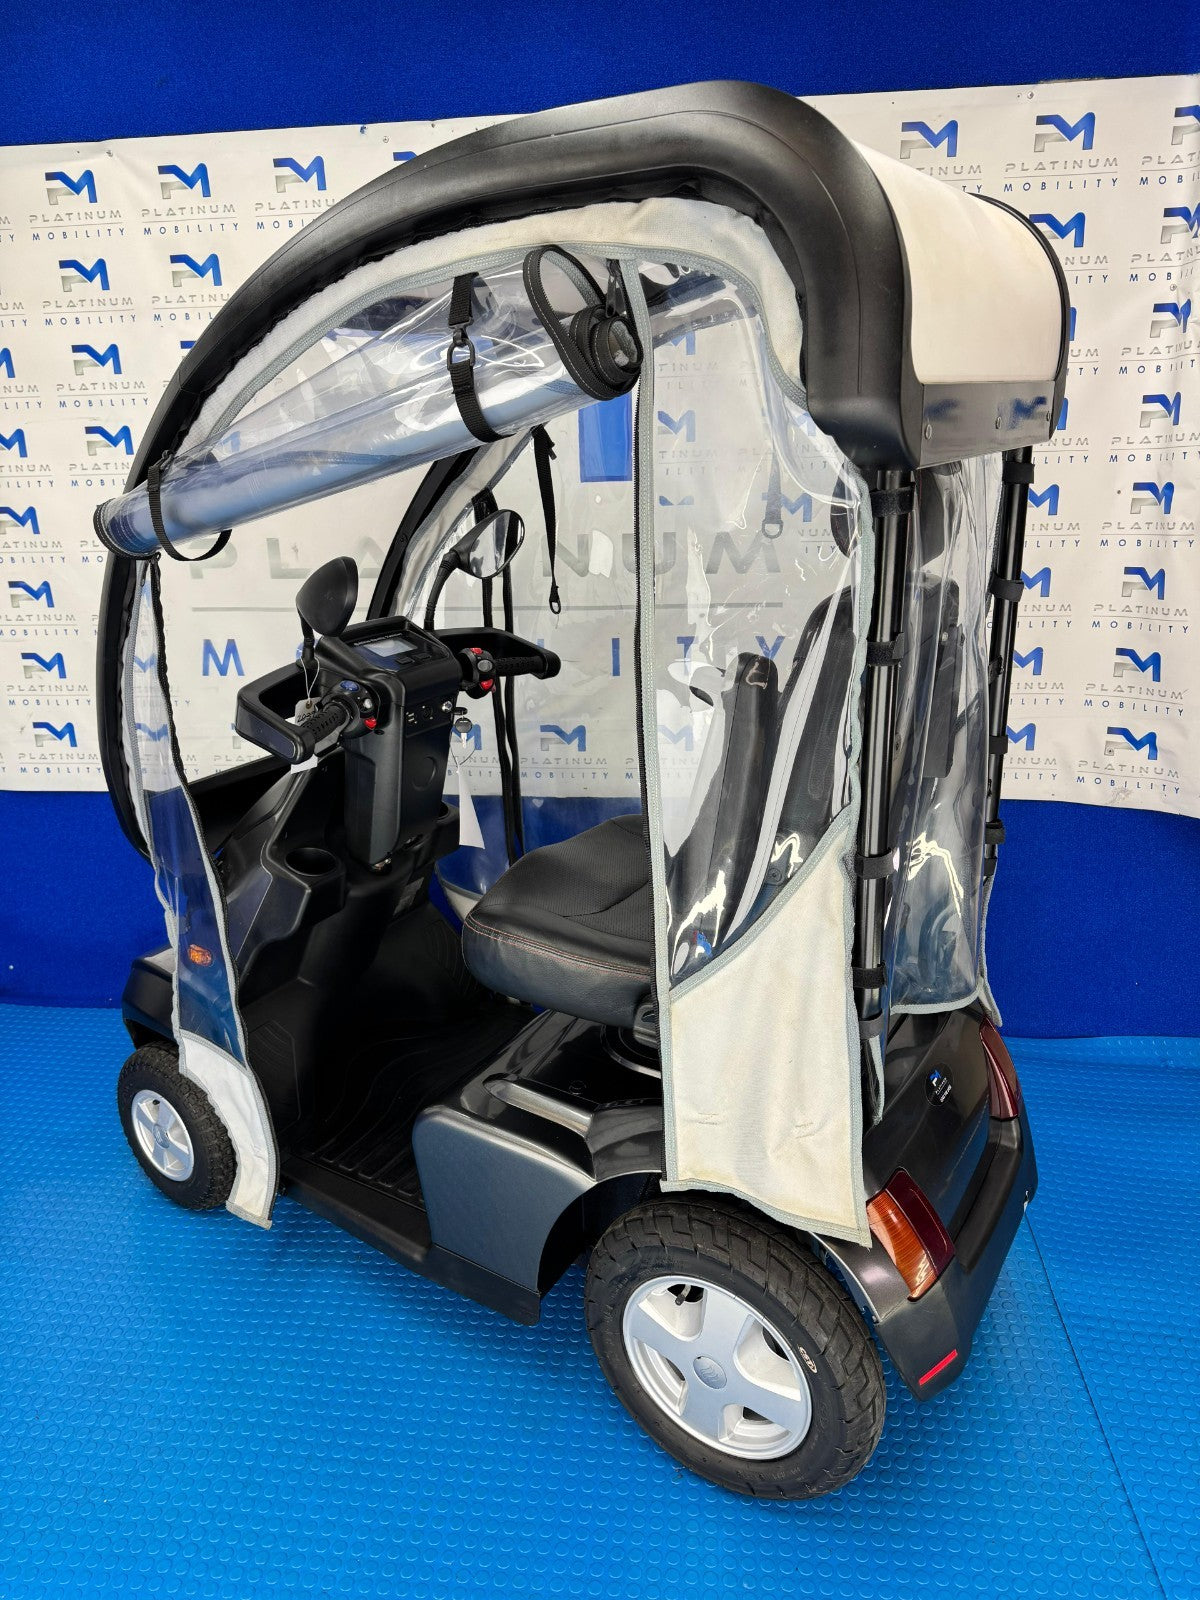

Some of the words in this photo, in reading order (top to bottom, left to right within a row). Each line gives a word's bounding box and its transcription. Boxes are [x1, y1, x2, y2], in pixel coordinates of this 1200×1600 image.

[1004, 157, 1118, 172] PLATINUM
[1003, 178, 1118, 192] MOBILITY
[141, 203, 236, 217] PLATINUM
[255, 198, 335, 211] PLATINU
[29, 209, 122, 223] PLATINUM
[143, 222, 239, 235] MOBILITY
[256, 219, 304, 230] MOBI
[32, 227, 125, 241] MOBILITY
[42, 296, 133, 309] PLATINUM
[152, 293, 230, 304] PLATINU
[45, 314, 136, 326] MOBILITY
[153, 312, 214, 321] MOBIL
[56, 380, 146, 392] PLATINUM
[4, 401, 42, 409] LITY
[59, 397, 149, 408] MOBILITY
[1032, 455, 1089, 464] ILITY
[69, 462, 130, 471] PLATIN
[7, 480, 54, 488] ILITY
[71, 479, 126, 487] MOBIL
[1031, 521, 1081, 532] INUM
[1101, 520, 1195, 532] PLATINUM
[3, 540, 63, 549] ATINUM
[1024, 539, 1081, 548] ILITY
[1100, 539, 1195, 548] MOBILITY
[1024, 603, 1072, 612] INUM
[1093, 603, 1189, 617] PLATINUM
[1092, 620, 1189, 634] MOBILITY
[7, 684, 89, 692] PLATINUM
[1016, 682, 1065, 690] INUM
[1086, 683, 1184, 700] PLATINUM
[9, 698, 91, 706] MOBILITY
[1009, 698, 1065, 706] ILITY
[1084, 699, 1184, 717] MOBILITY
[18, 753, 99, 761] PLATINUM
[520, 757, 608, 765] PLATINUM
[1009, 757, 1057, 766] INUM
[20, 765, 101, 774] MOBILITY
[520, 770, 609, 779] MOBILITY
[1078, 760, 1180, 779] PLATINUM
[1003, 772, 1058, 781] ILITY
[1076, 776, 1180, 795] MOBILITY
